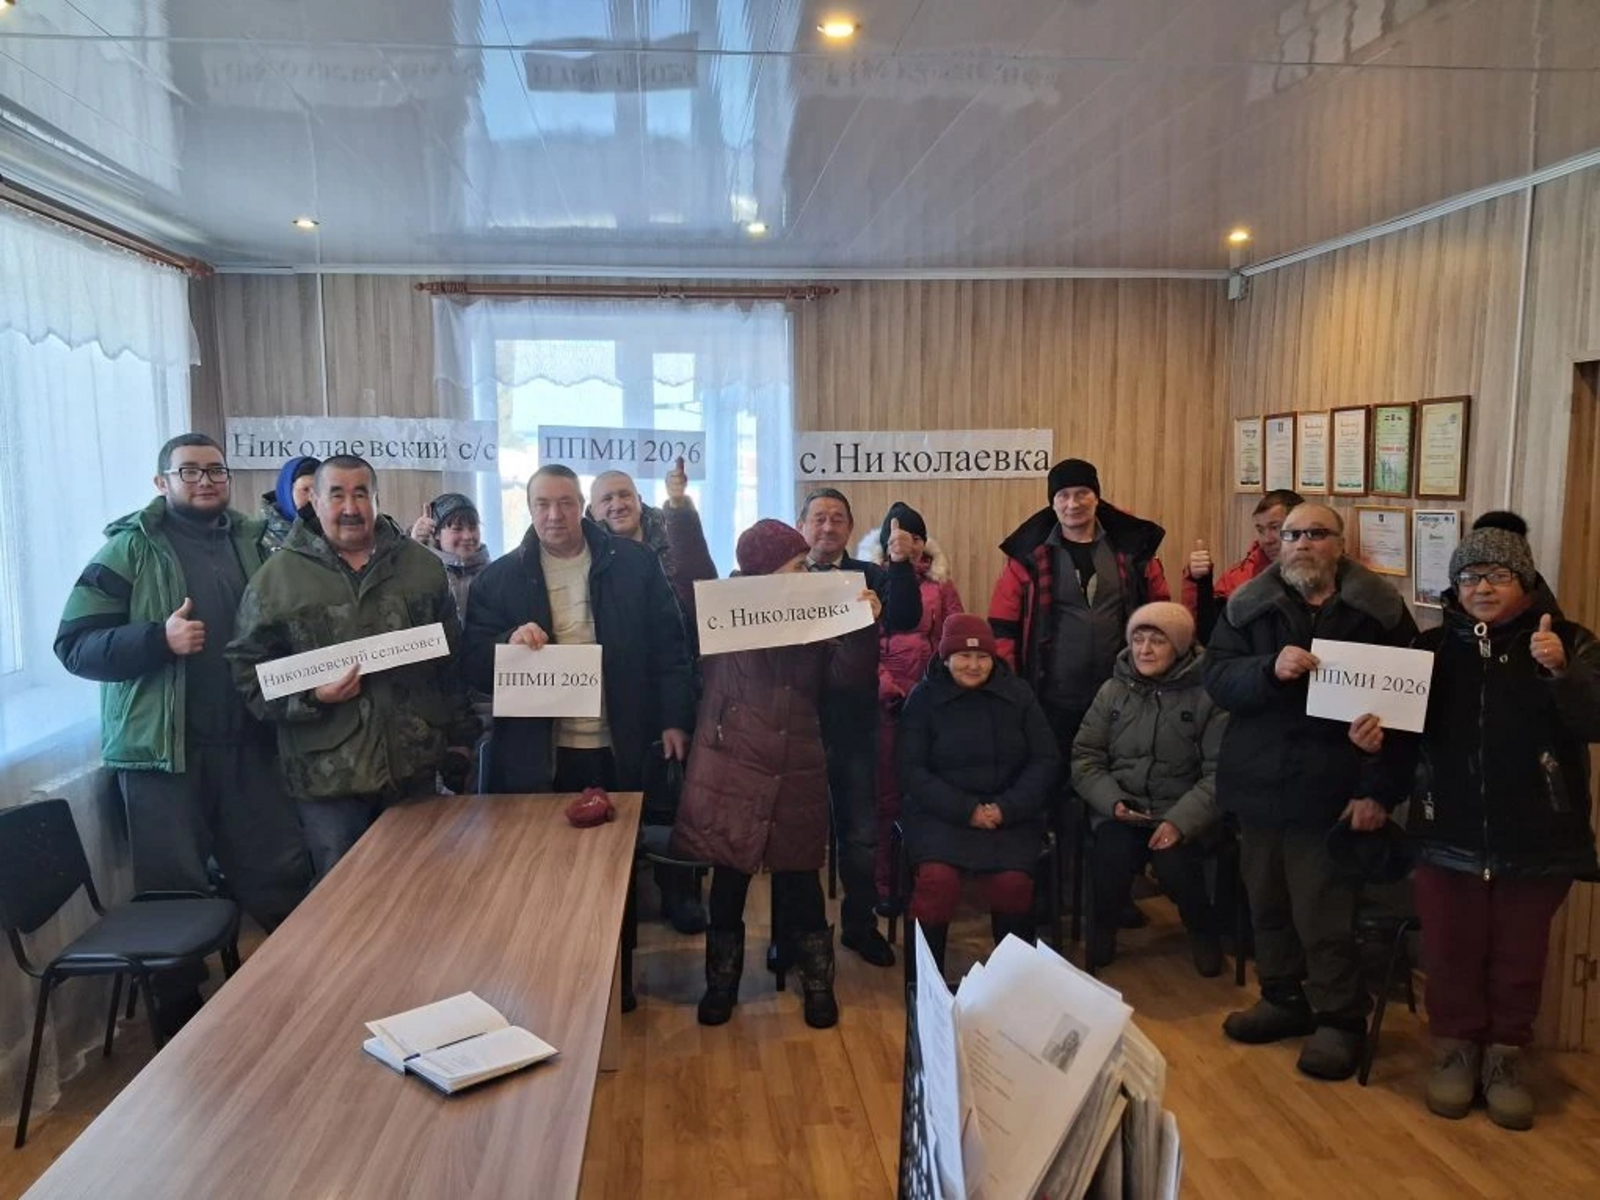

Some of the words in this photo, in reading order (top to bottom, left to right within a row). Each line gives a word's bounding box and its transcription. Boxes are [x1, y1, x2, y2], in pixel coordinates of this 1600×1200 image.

[545, 437, 636, 461] ППМИ
[644, 440, 700, 464] 2026
[800, 451, 826, 474] с.
[835, 443, 1049, 473] Николаевка
[707, 616, 724, 630] с.
[730, 602, 850, 628] Николаевка
[263, 650, 368, 688] Николаевский
[371, 636, 442, 659] сельсовет
[498, 672, 555, 686] ППМИ
[561, 672, 598, 687] 2026
[1312, 667, 1376, 689] ППМИ
[1381, 675, 1426, 696] 2026
